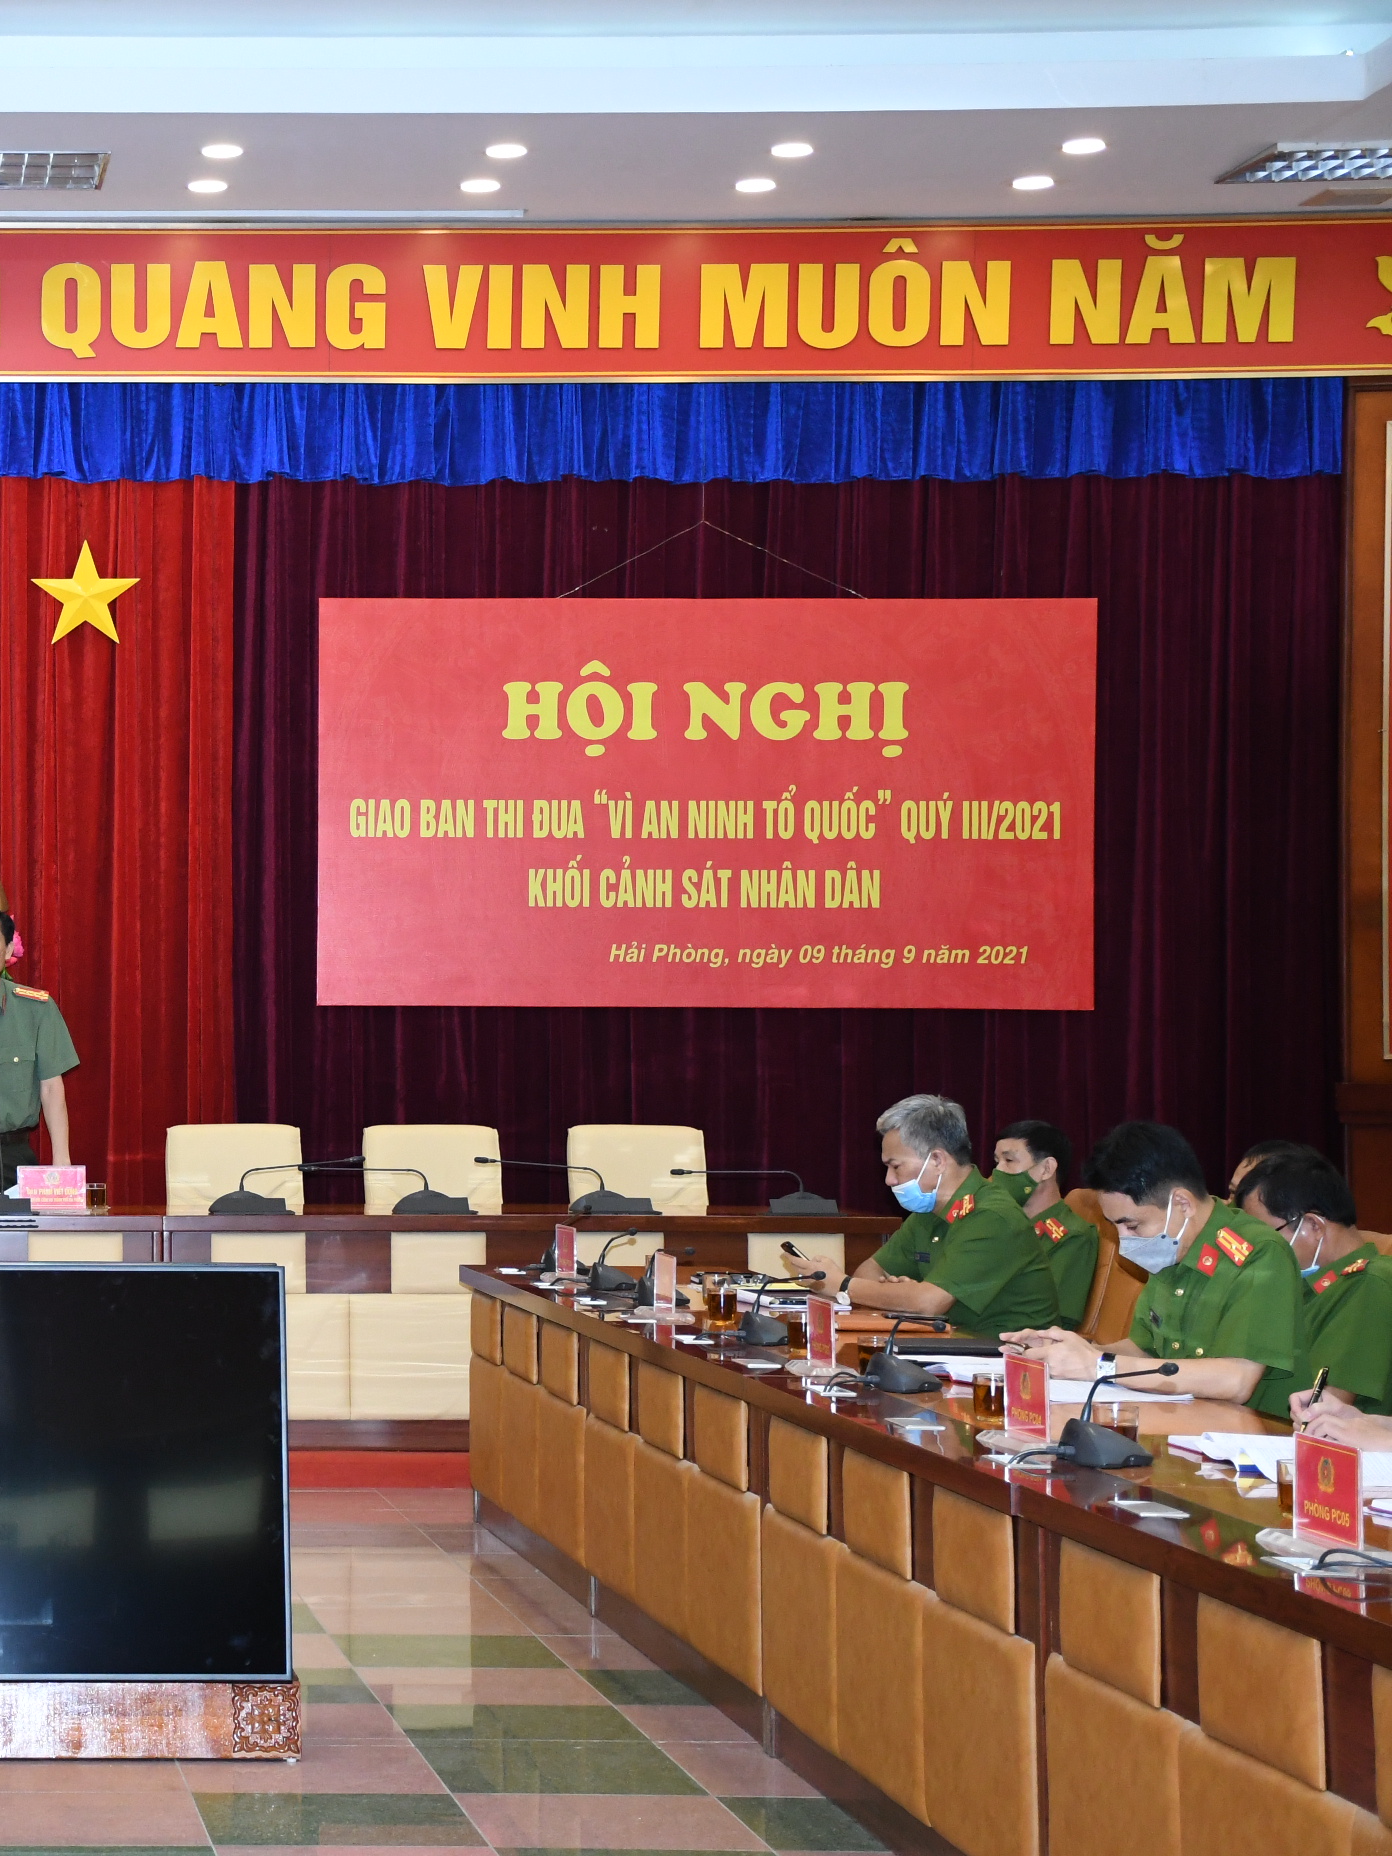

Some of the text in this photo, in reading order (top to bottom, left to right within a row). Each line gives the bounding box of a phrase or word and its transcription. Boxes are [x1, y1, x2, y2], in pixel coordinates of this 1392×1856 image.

[41, 261, 387, 358] QUANG
[424, 264, 661, 349] VINH
[700, 238, 1012, 349] MUÔN
[1049, 233, 1297, 345] NĂM
[502, 659, 910, 759] HỘI NGHỊ
[349, 797, 411, 839] GIAO
[419, 798, 475, 838] BAN
[483, 799, 524, 839] THI
[531, 799, 585, 839] ĐUA
[641, 799, 679, 839] AN
[688, 799, 754, 840] NINH
[762, 784, 797, 840] TỔ
[900, 791, 953, 844] QUÝ
[962, 800, 1061, 841] III/2021
[528, 854, 881, 909] KHỐI CẢNH SÁT NHÂN DÂN
[609, 941, 1029, 969] Hải Phòng, ngày 09 tháng 9 năm 2021
[1303, 1499, 1350, 1527] PHÒNG PC05
